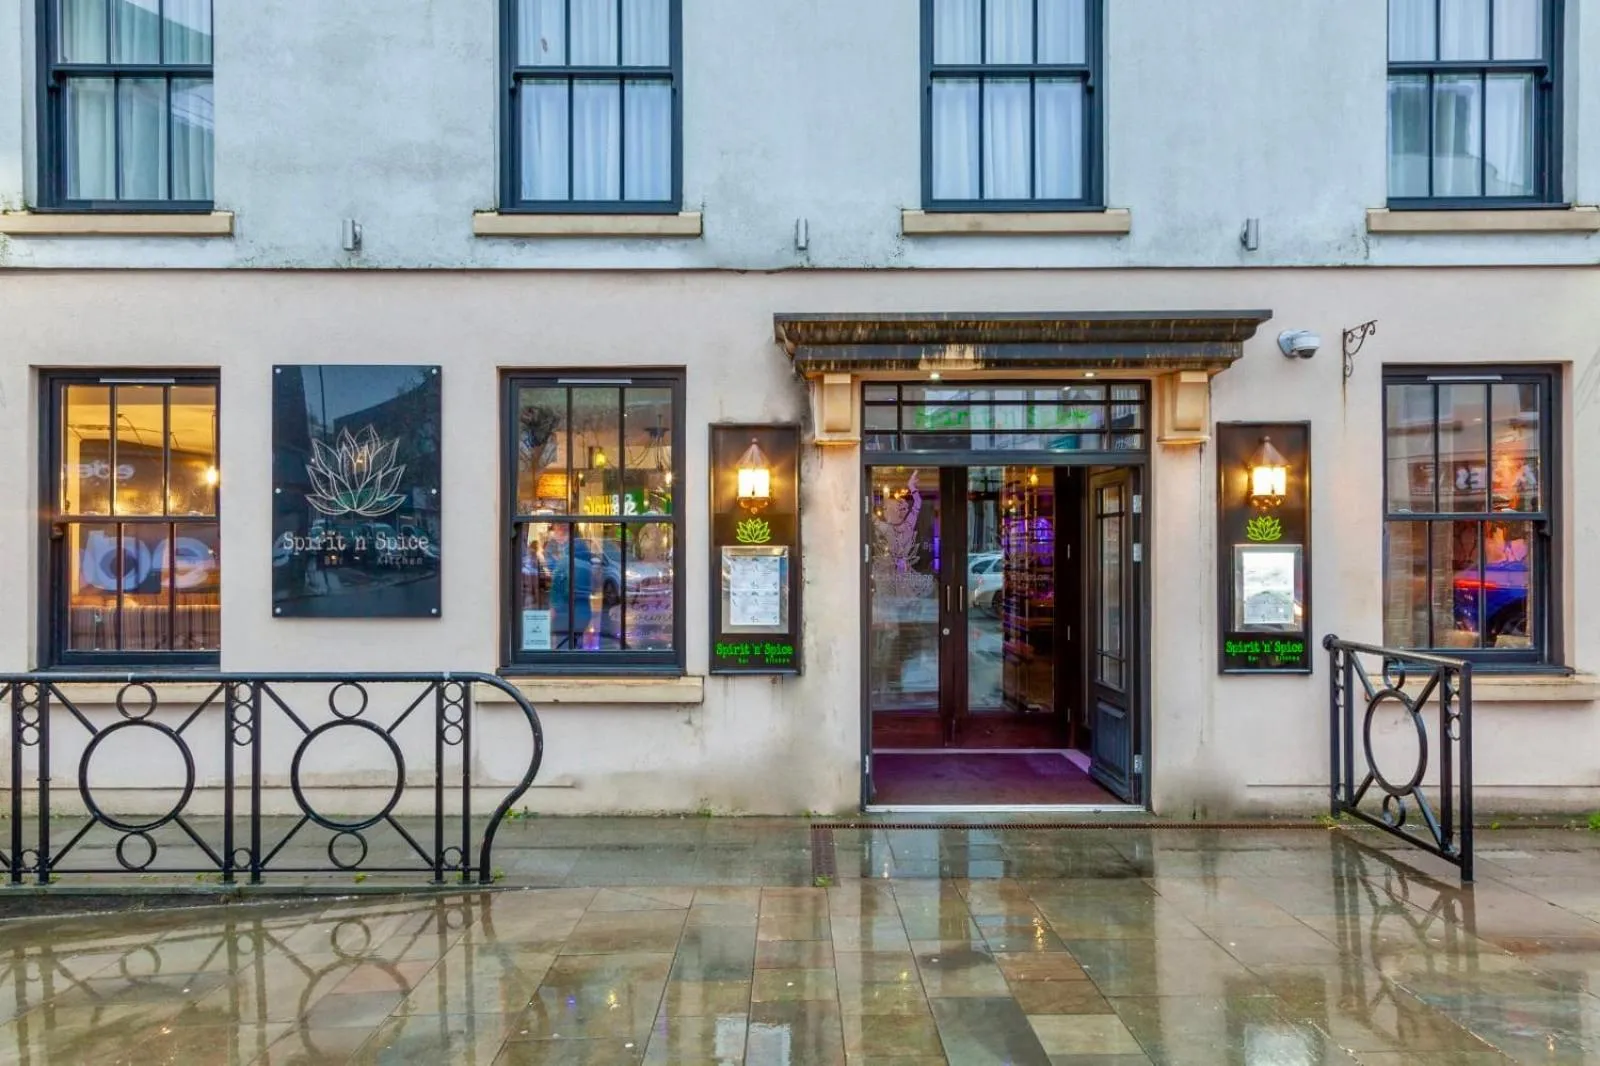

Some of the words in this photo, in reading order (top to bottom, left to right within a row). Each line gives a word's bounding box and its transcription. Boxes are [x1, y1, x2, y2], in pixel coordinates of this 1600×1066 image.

[283, 531, 346, 555] Spirit
[375, 531, 429, 555] Spice
[716, 643, 750, 658] Spirit
[764, 643, 793, 658] Spice
[1225, 641, 1260, 656] Spirit
[1274, 641, 1303, 656] Spice
